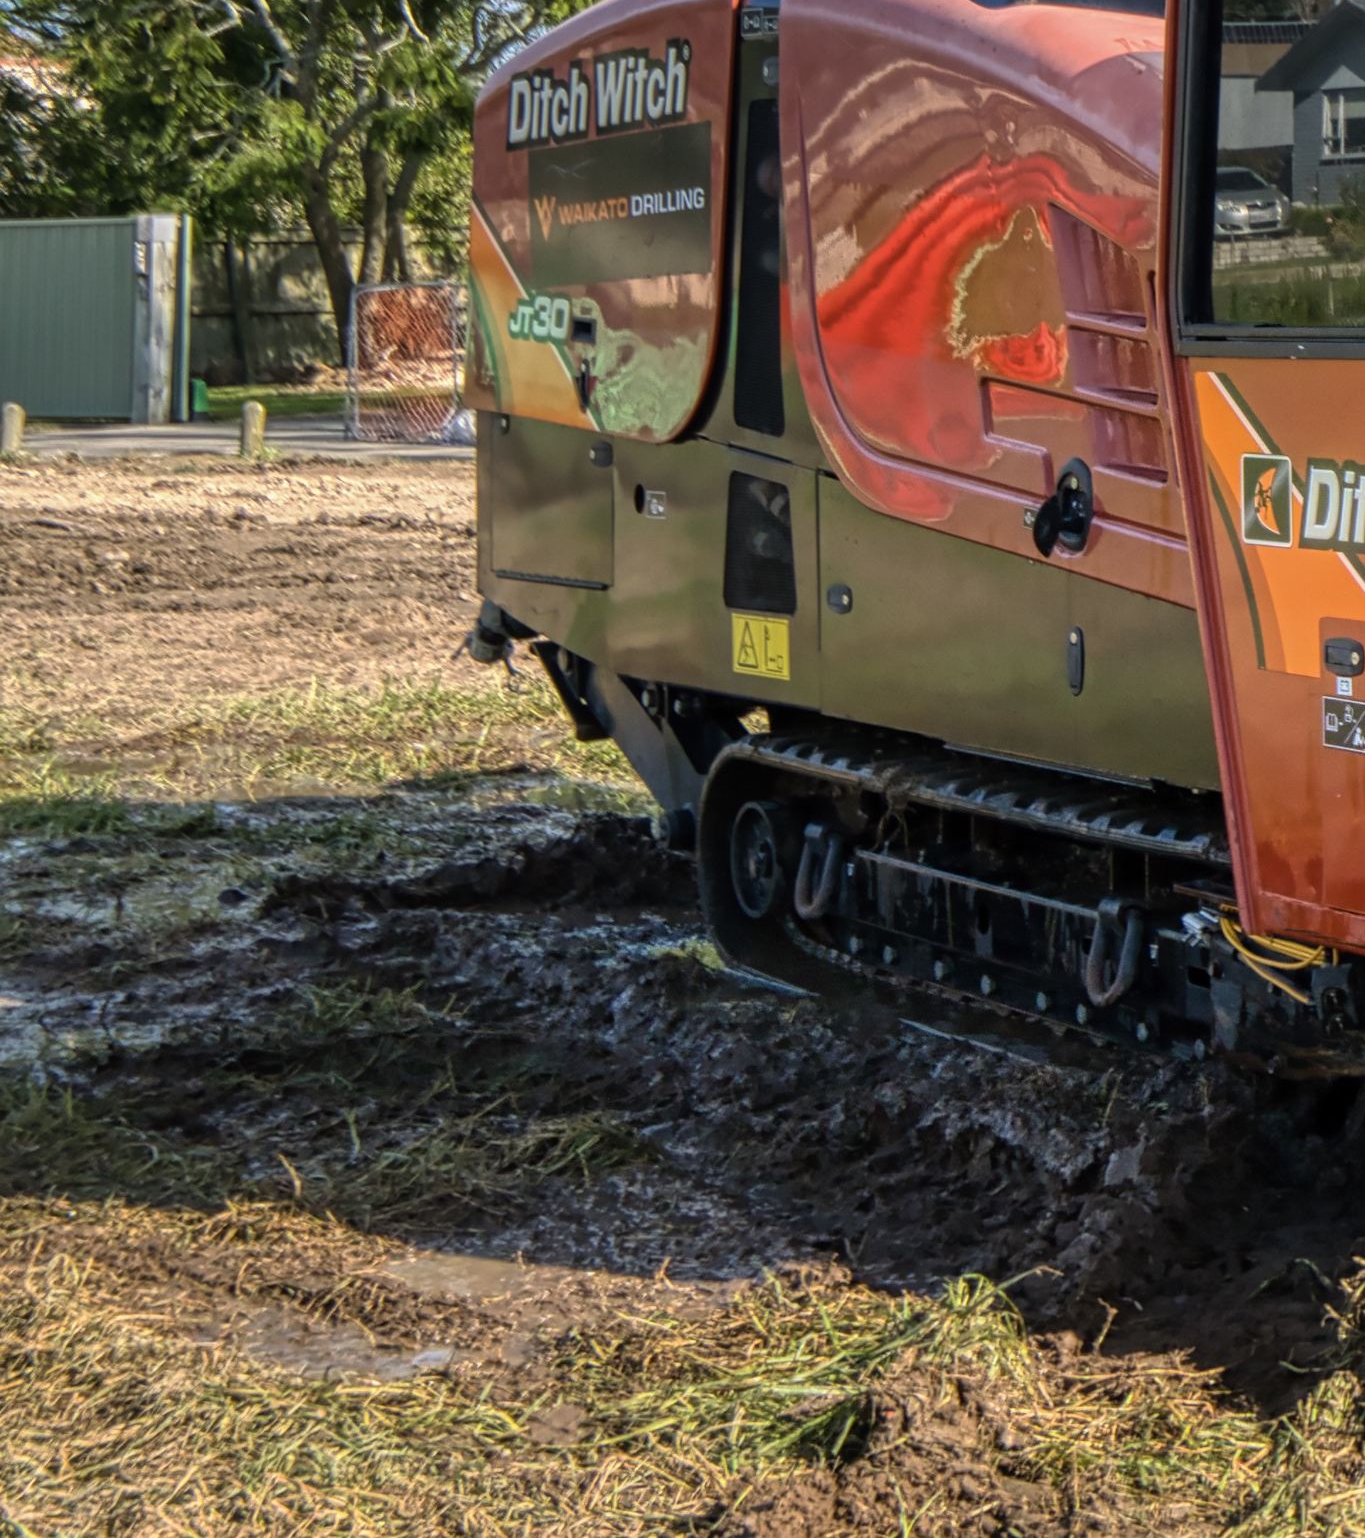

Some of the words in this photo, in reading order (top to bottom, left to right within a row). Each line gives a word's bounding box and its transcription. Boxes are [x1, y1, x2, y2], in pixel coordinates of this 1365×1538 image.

[508, 68, 590, 144] Ditch
[558, 197, 629, 226] WAIKATO
[630, 187, 706, 217] DRILLING
[509, 295, 571, 340] JT30
